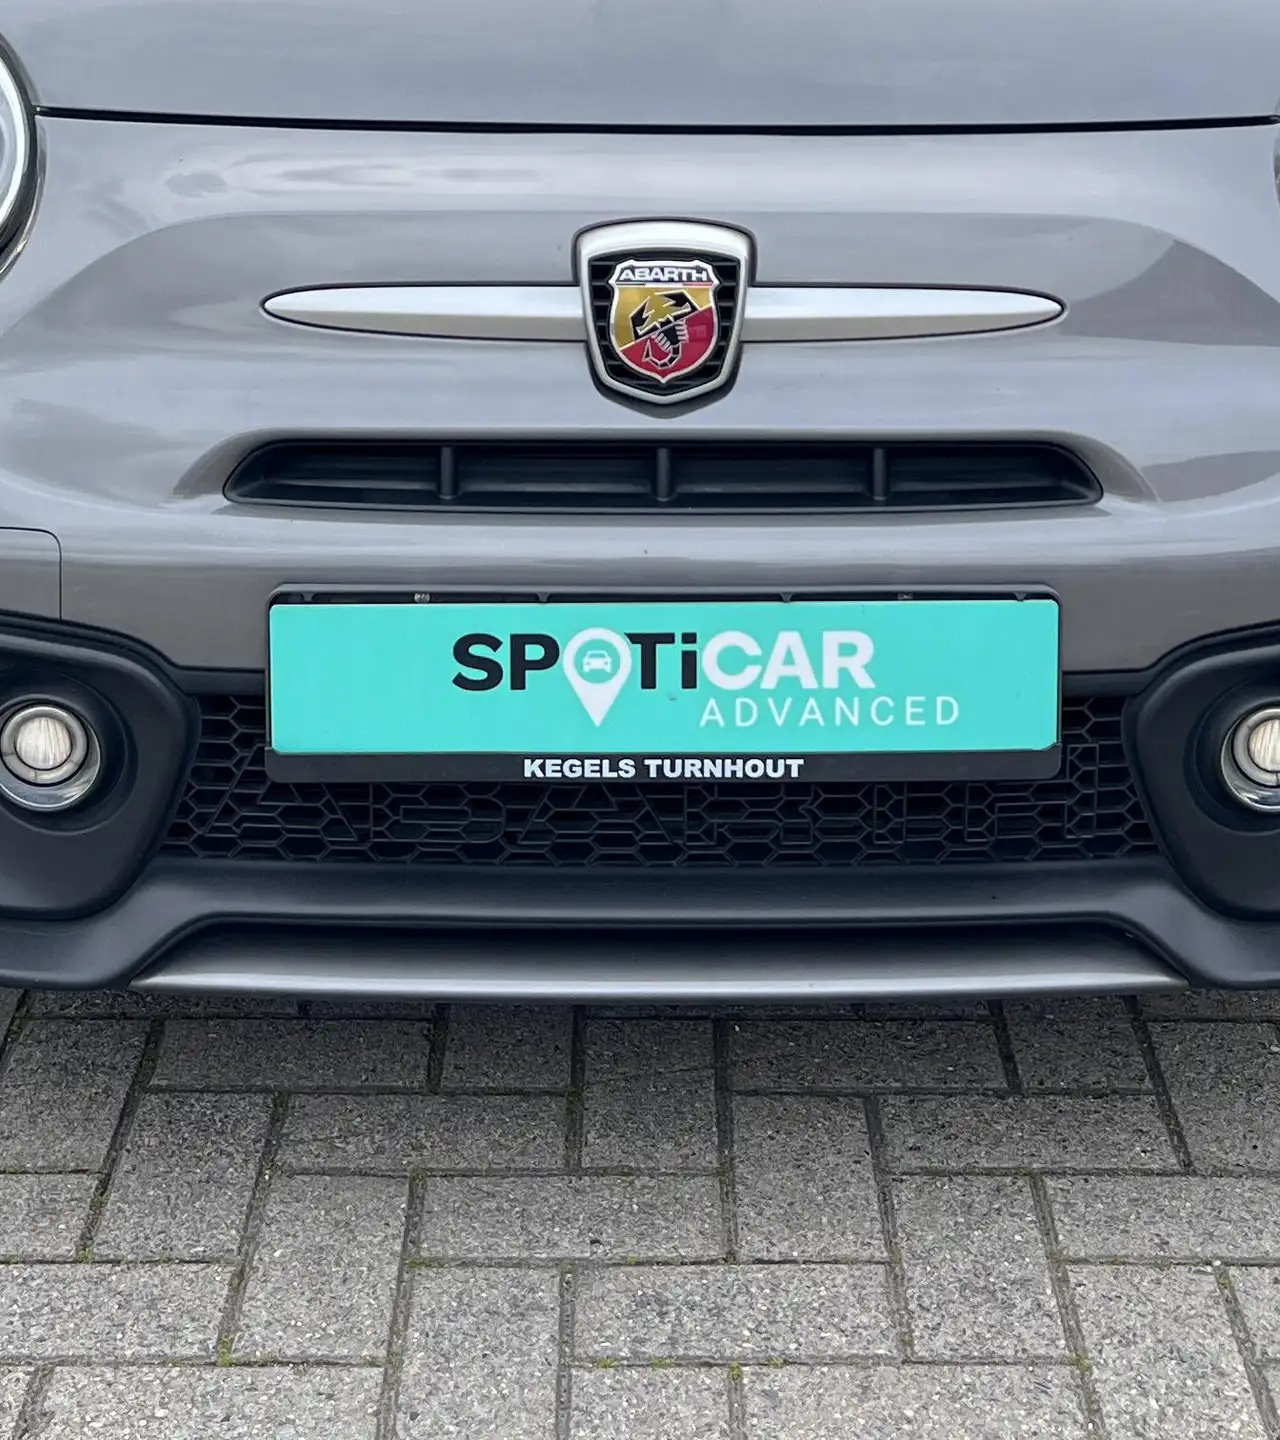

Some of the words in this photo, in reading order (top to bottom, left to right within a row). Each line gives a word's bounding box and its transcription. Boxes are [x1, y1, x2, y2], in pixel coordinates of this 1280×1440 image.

[620, 267, 707, 281] ABARTH
[699, 695, 960, 728] ADVANCED
[523, 758, 637, 779] KEGELS
[643, 758, 806, 779] TURNHOUT
